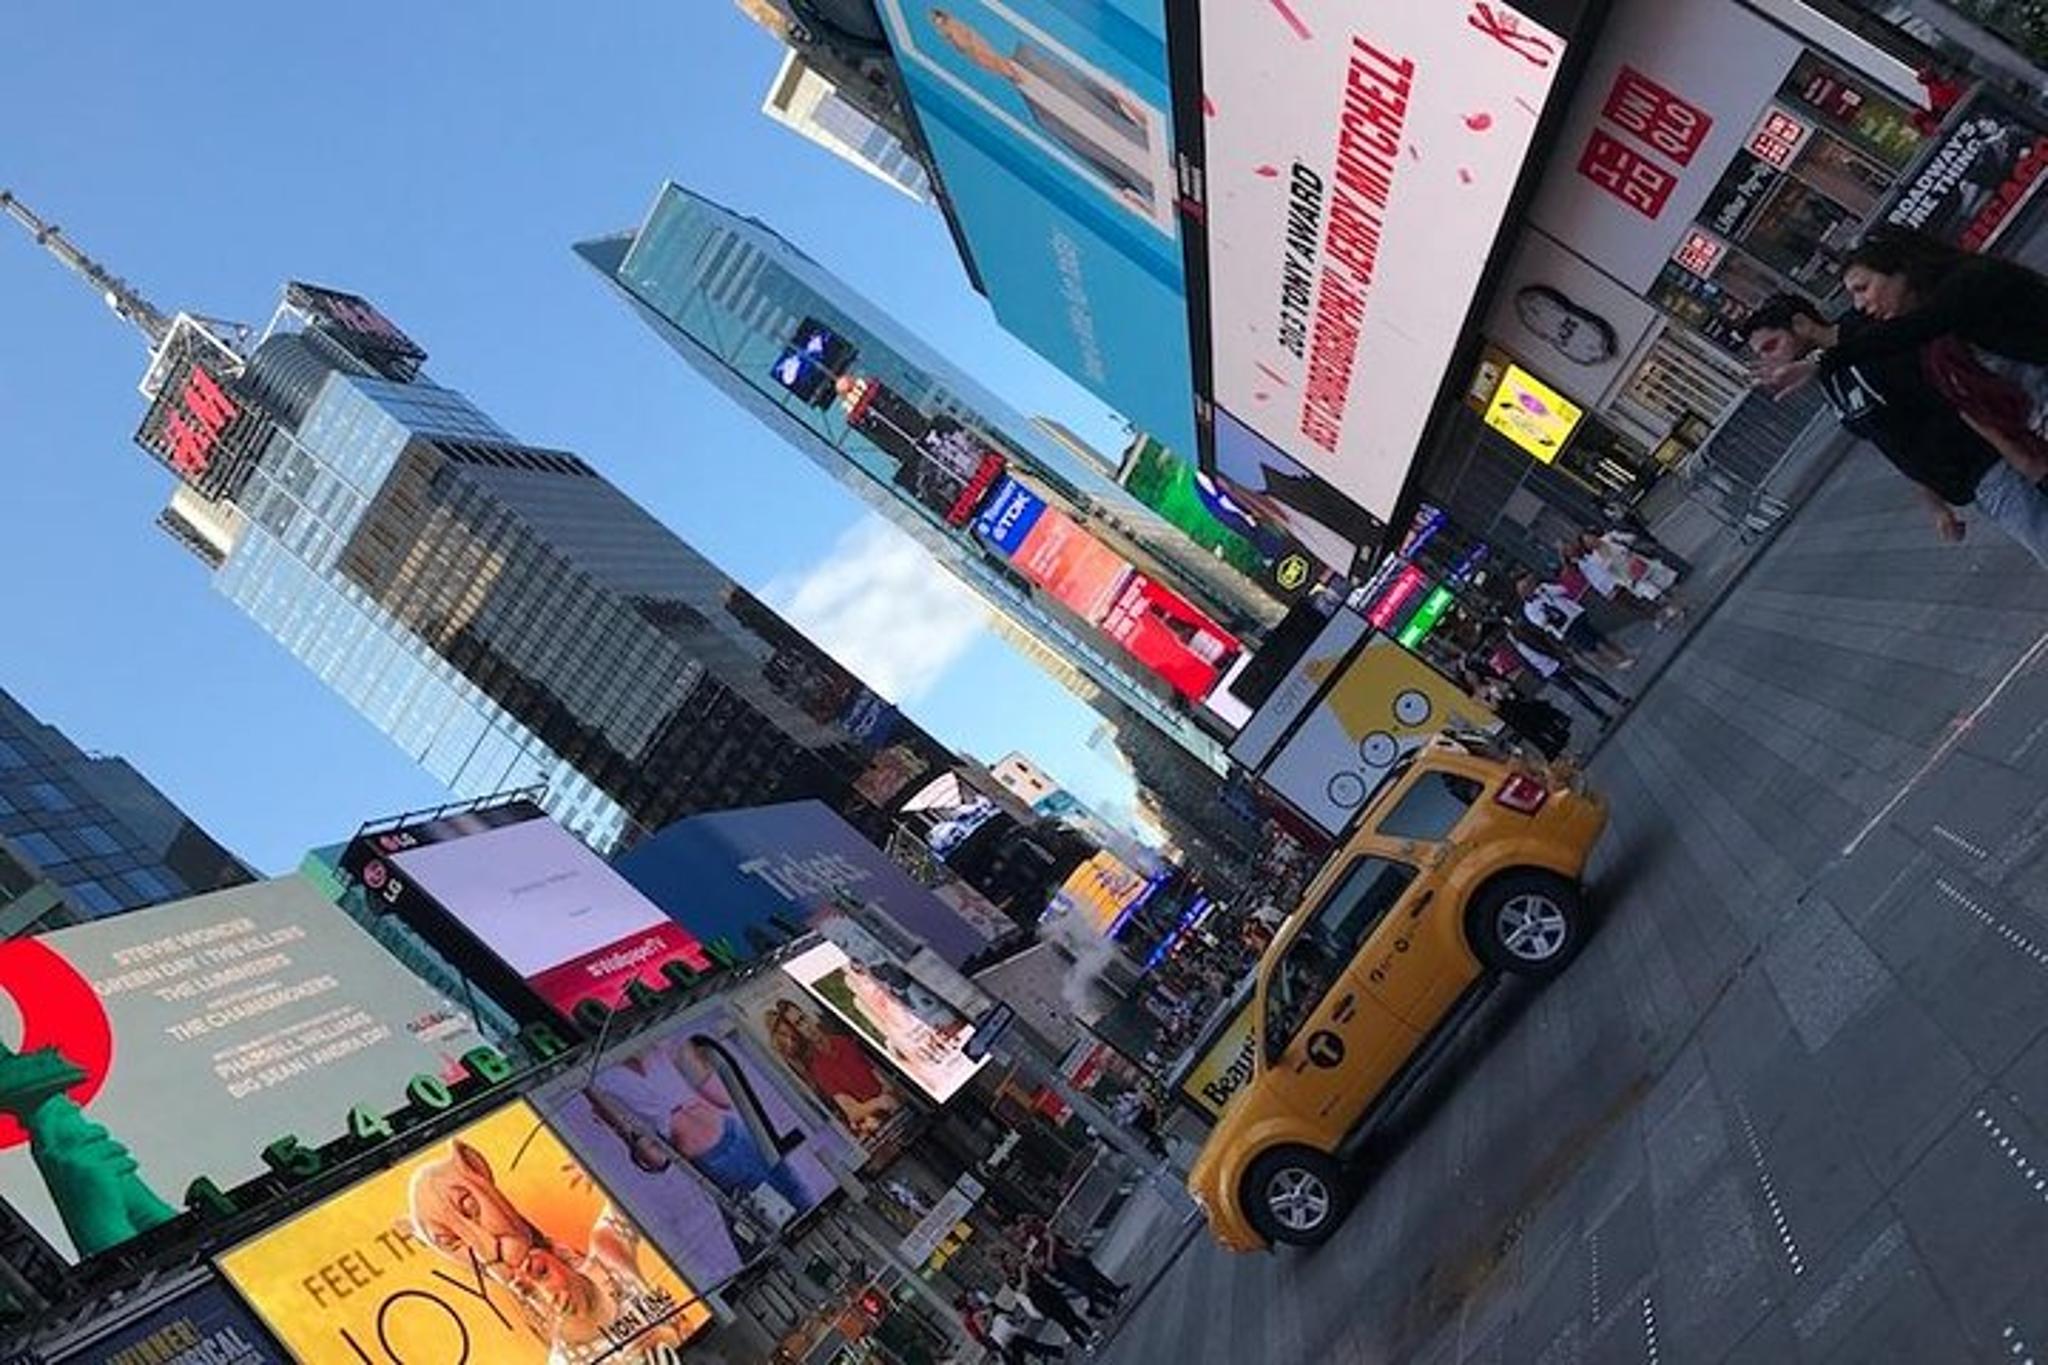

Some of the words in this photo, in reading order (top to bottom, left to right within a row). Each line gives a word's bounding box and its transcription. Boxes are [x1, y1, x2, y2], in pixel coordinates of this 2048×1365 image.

[1335, 34, 1416, 208] MITCHELL
[1612, 81, 1661, 132] UNI
[1650, 102, 1698, 154] QLO
[1932, 138, 1981, 198] THING
[1286, 160, 1324, 268] AWARD
[1324, 186, 1386, 287] JERRY
[1280, 252, 1315, 325] TONY
[383, 878, 403, 902] LG
[303, 1247, 383, 1309] FEEL
[376, 1225, 430, 1266] TH
